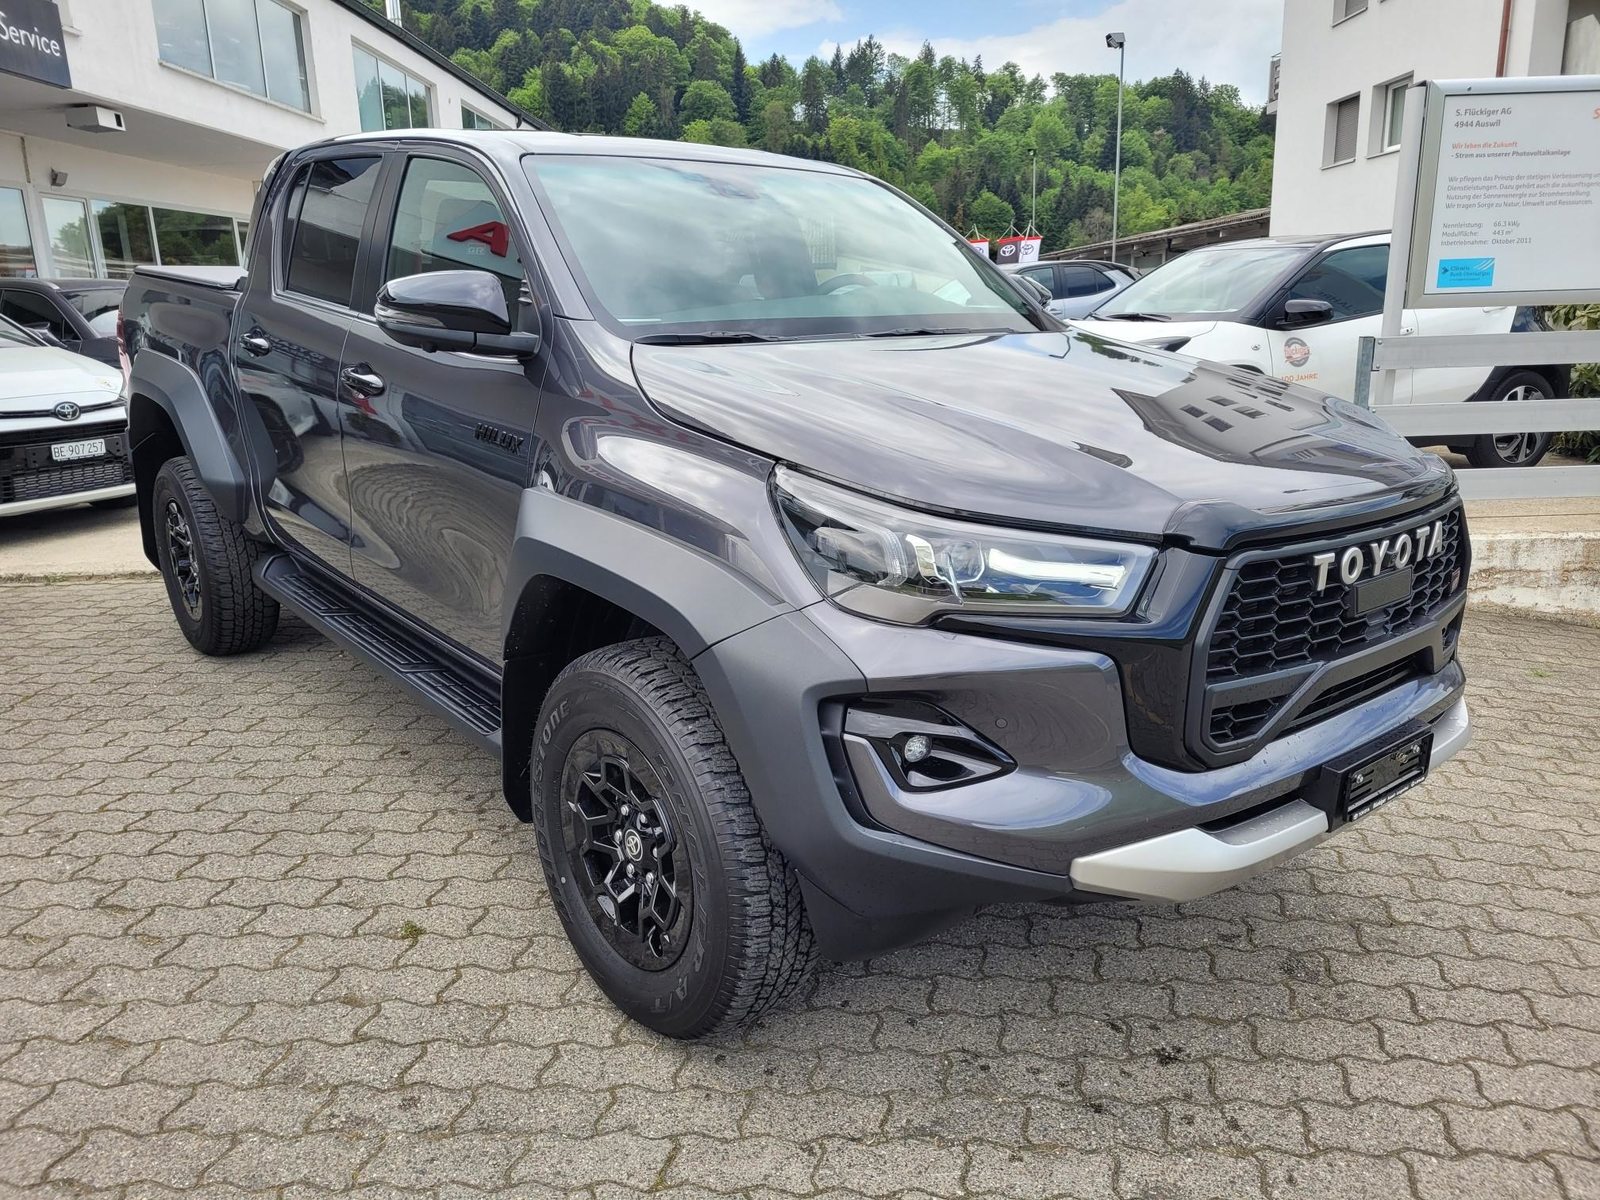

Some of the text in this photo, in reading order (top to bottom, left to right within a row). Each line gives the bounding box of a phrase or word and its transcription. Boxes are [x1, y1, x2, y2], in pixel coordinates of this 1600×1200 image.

[0, 11, 61, 56] Service
[1464, 108, 1499, 117] Flückiger
[1500, 107, 1512, 115] AG
[1454, 119, 1501, 128] 4944 Auswil
[1295, 373, 1318, 381] JAHRE
[475, 422, 524, 456] HILUX
[53, 447, 66, 458] BE
[1313, 520, 1444, 592] TOYOTA
